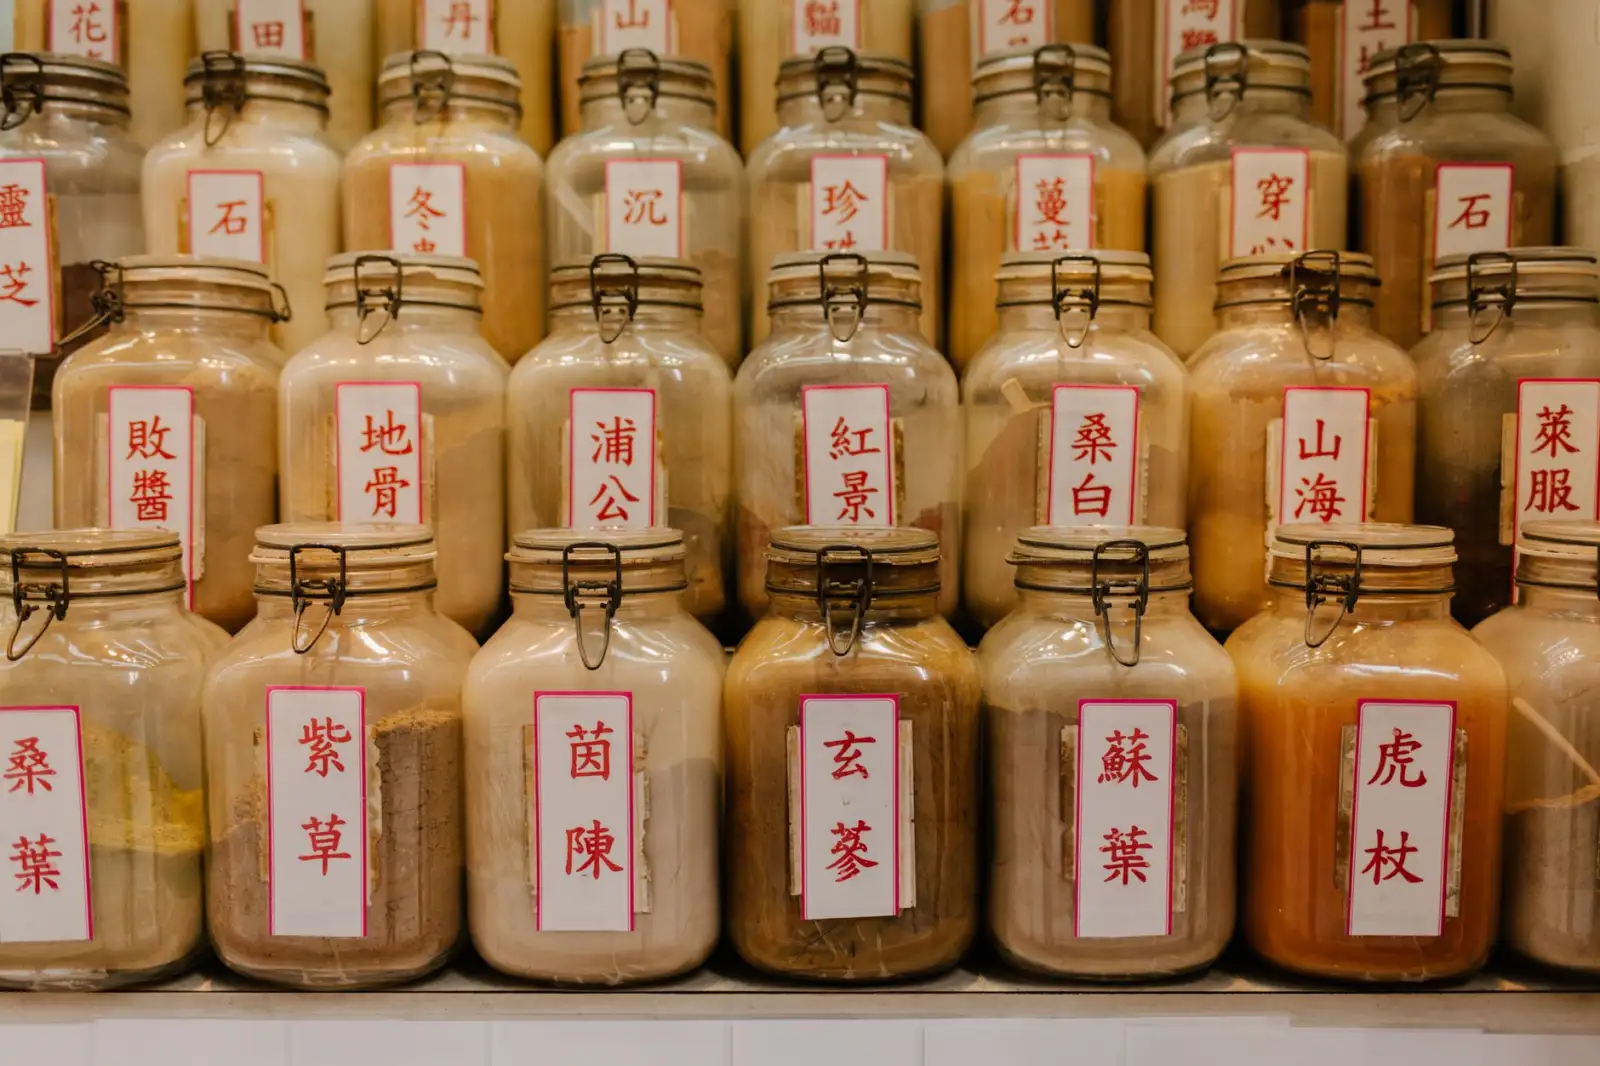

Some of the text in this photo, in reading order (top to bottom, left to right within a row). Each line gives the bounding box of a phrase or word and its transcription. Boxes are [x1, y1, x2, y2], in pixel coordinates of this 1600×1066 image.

[69, 2, 107, 60] 花
[0, 184, 40, 307] 靈芝
[207, 199, 249, 237] 石
[623, 189, 670, 226] 沉
[1446, 193, 1492, 230] 石
[126, 414, 177, 522] 敗醬
[360, 408, 413, 518] 地骨
[589, 415, 641, 522] 浦公
[829, 416, 882, 524] 紅景
[1071, 411, 1118, 520] 桑白
[1293, 418, 1347, 523] 山海
[1524, 404, 1581, 513] 萊服
[2, 736, 62, 895] 桑葉
[298, 717, 353, 877] 紫草
[564, 720, 625, 880] 茵陳
[1097, 728, 1159, 886] 蘇葉
[1361, 727, 1428, 887] 虎杖
